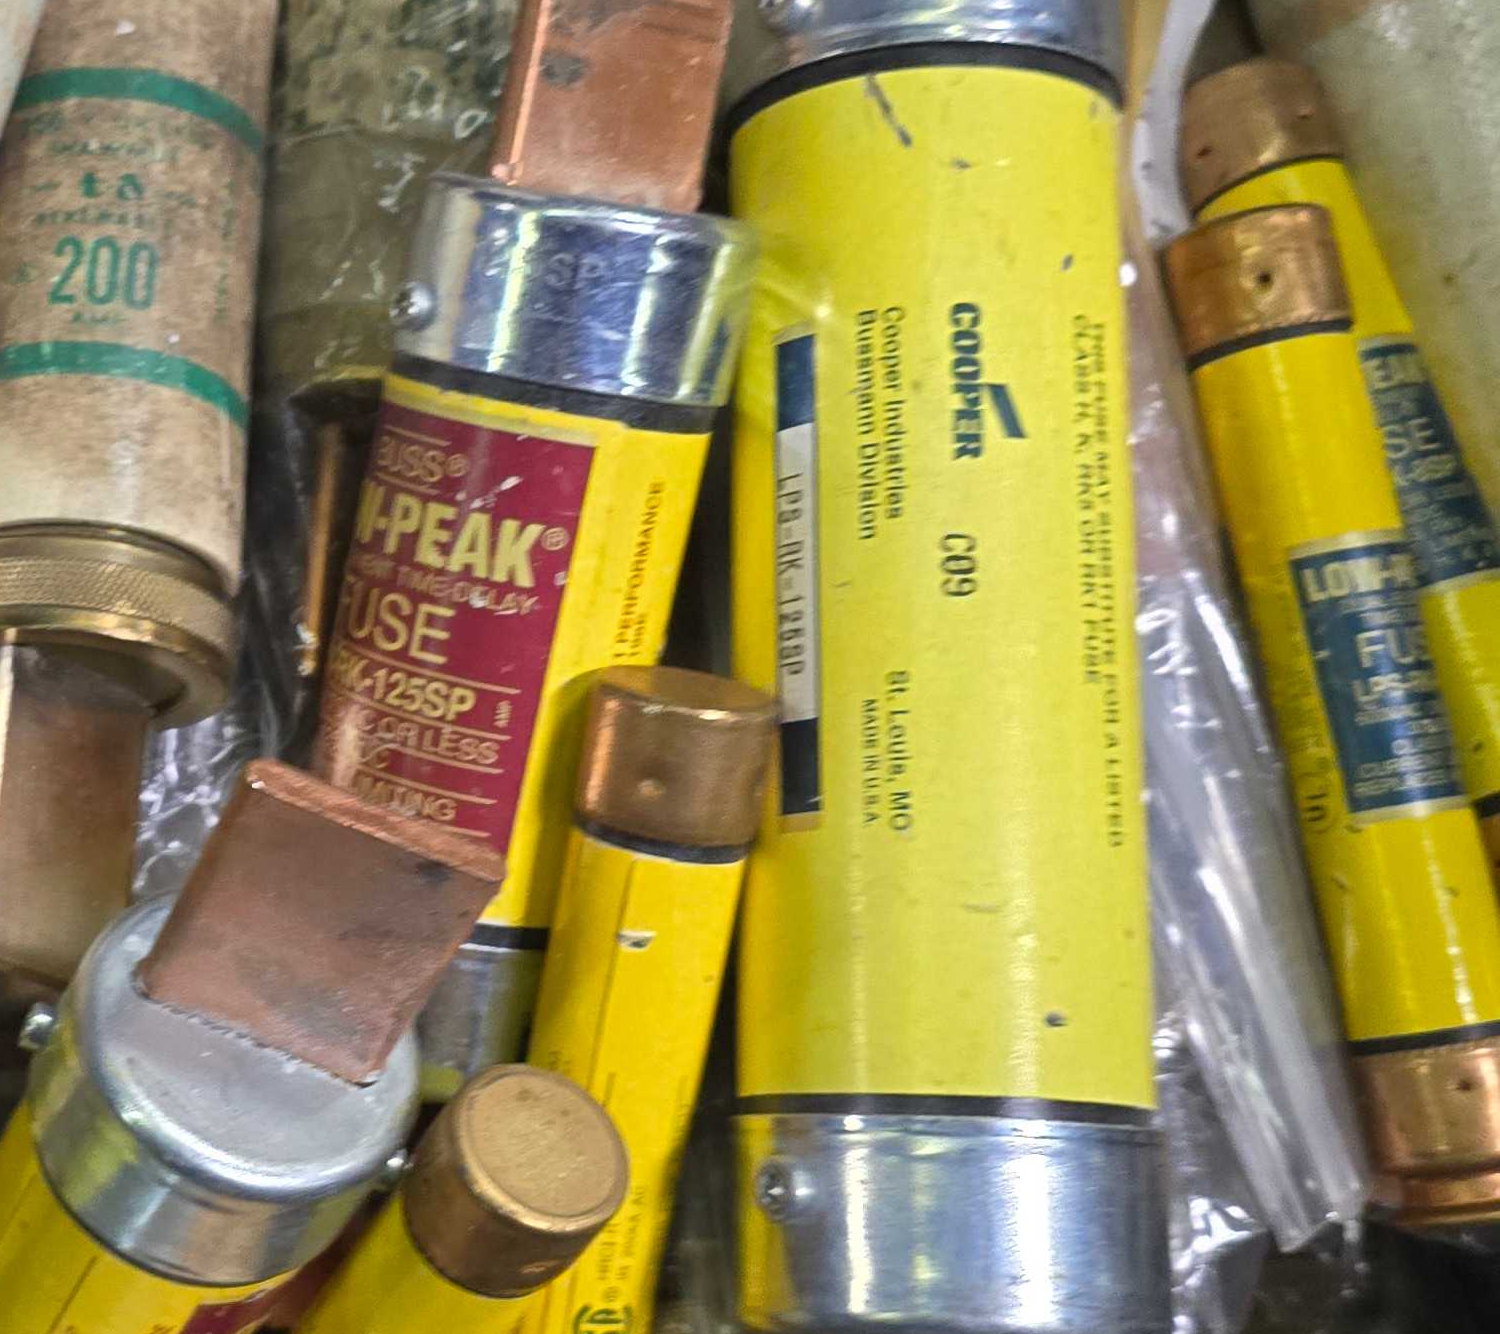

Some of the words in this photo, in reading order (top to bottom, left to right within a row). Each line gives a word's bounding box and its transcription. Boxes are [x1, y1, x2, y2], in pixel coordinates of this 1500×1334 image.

[47, 234, 161, 311] 200
[854, 309, 879, 435] Bussmann
[880, 306, 908, 392] Cooper
[949, 301, 986, 461] COOPER
[857, 442, 880, 540] Division
[884, 398, 908, 520] Industries
[616, 480, 666, 647] PERFORMANCE
